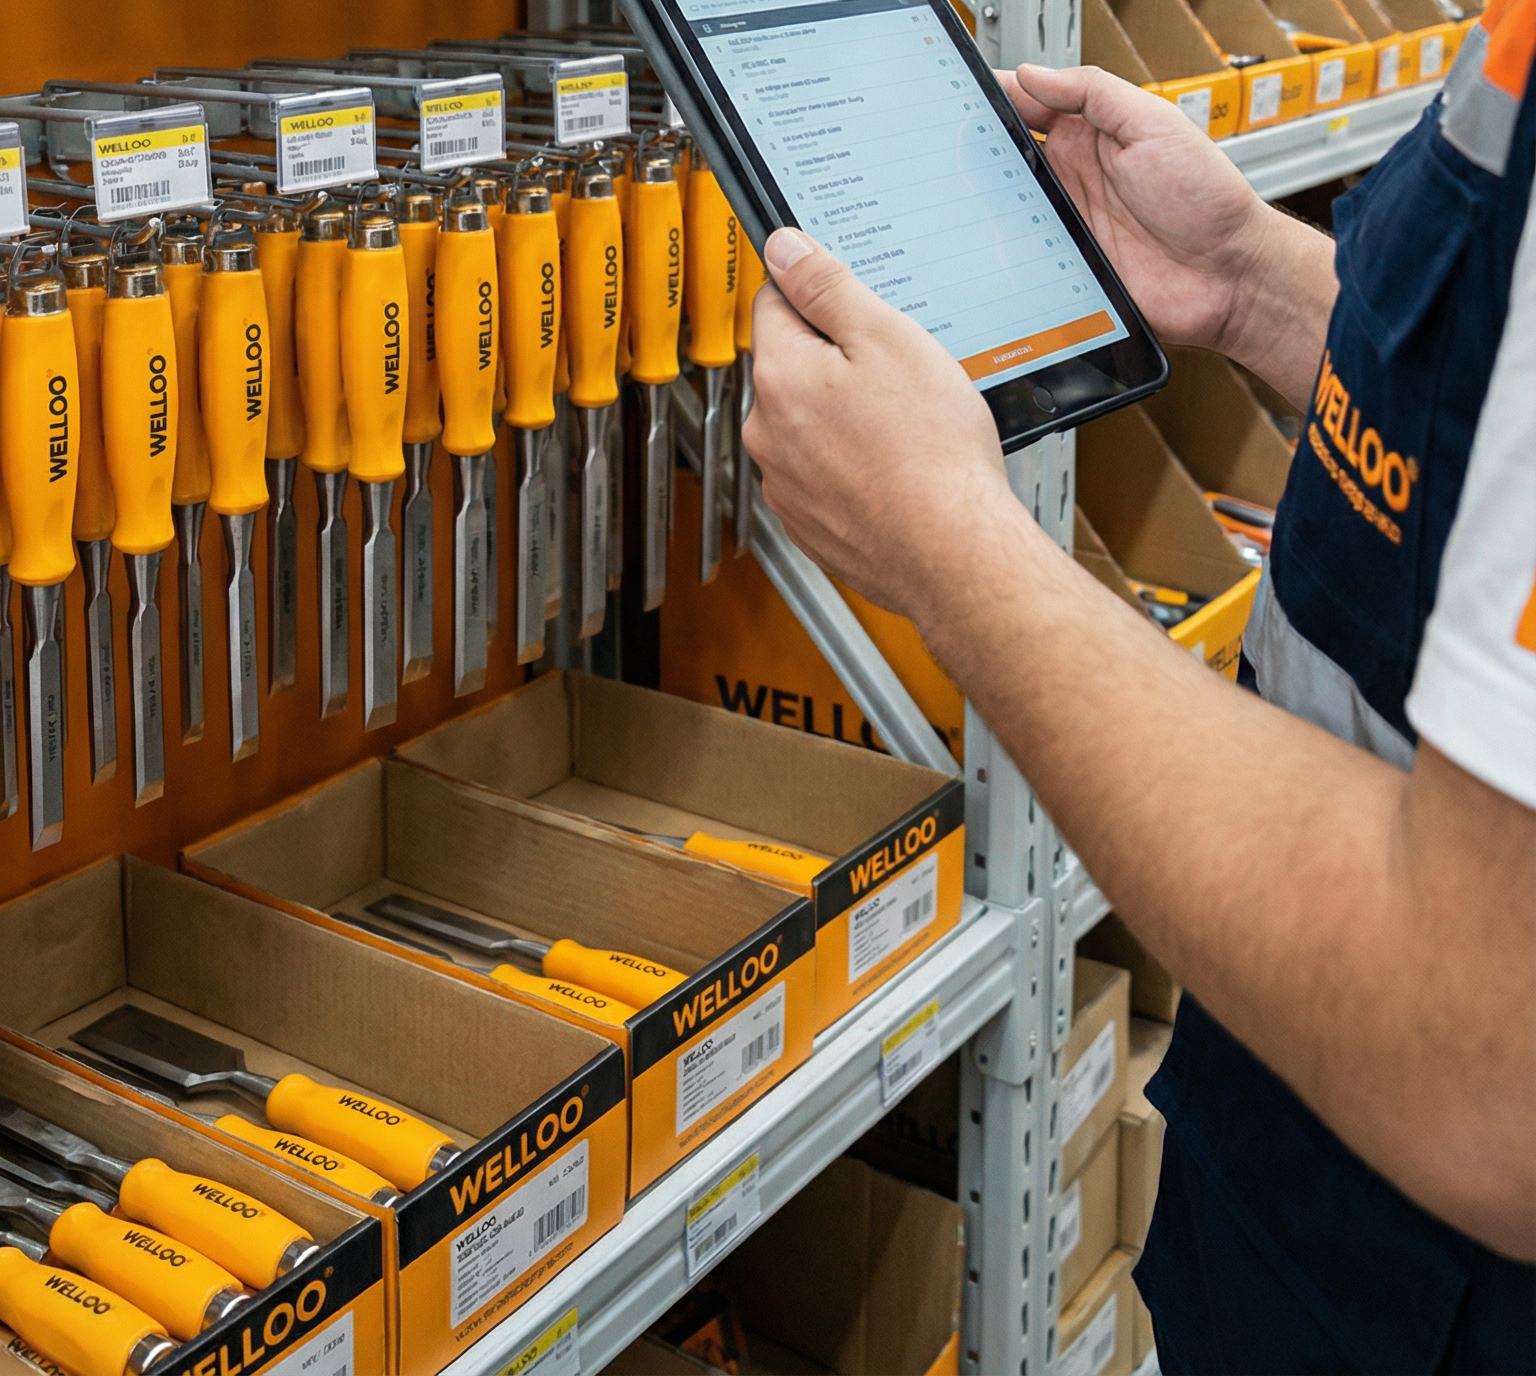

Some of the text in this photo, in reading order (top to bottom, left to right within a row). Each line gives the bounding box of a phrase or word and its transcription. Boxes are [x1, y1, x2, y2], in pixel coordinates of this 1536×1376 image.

[99, 139, 151, 154] WELLOO
[604, 245, 617, 329] WELLOO
[668, 227, 680, 308] WELLOO
[727, 216, 736, 293] WELLOO
[479, 281, 492, 371] WELLOO
[541, 263, 554, 349] WELLOO
[246, 324, 262, 421] WELLOO
[385, 302, 400, 394] WELLOO
[50, 376, 68, 482] WELLOO
[150, 355, 167, 457] WELLOO
[850, 817, 936, 895] WELLOO
[549, 983, 607, 1009] WELLOO
[609, 954, 666, 977] WELLOO
[672, 943, 778, 1038] WELLOO
[339, 1095, 400, 1126] WELLOO
[274, 1137, 338, 1170] WELLOO
[450, 1096, 583, 1216] WELLOO
[193, 1183, 258, 1218] WELLOO
[123, 1230, 186, 1267] WELLOO
[45, 1275, 110, 1314] WELLOO
